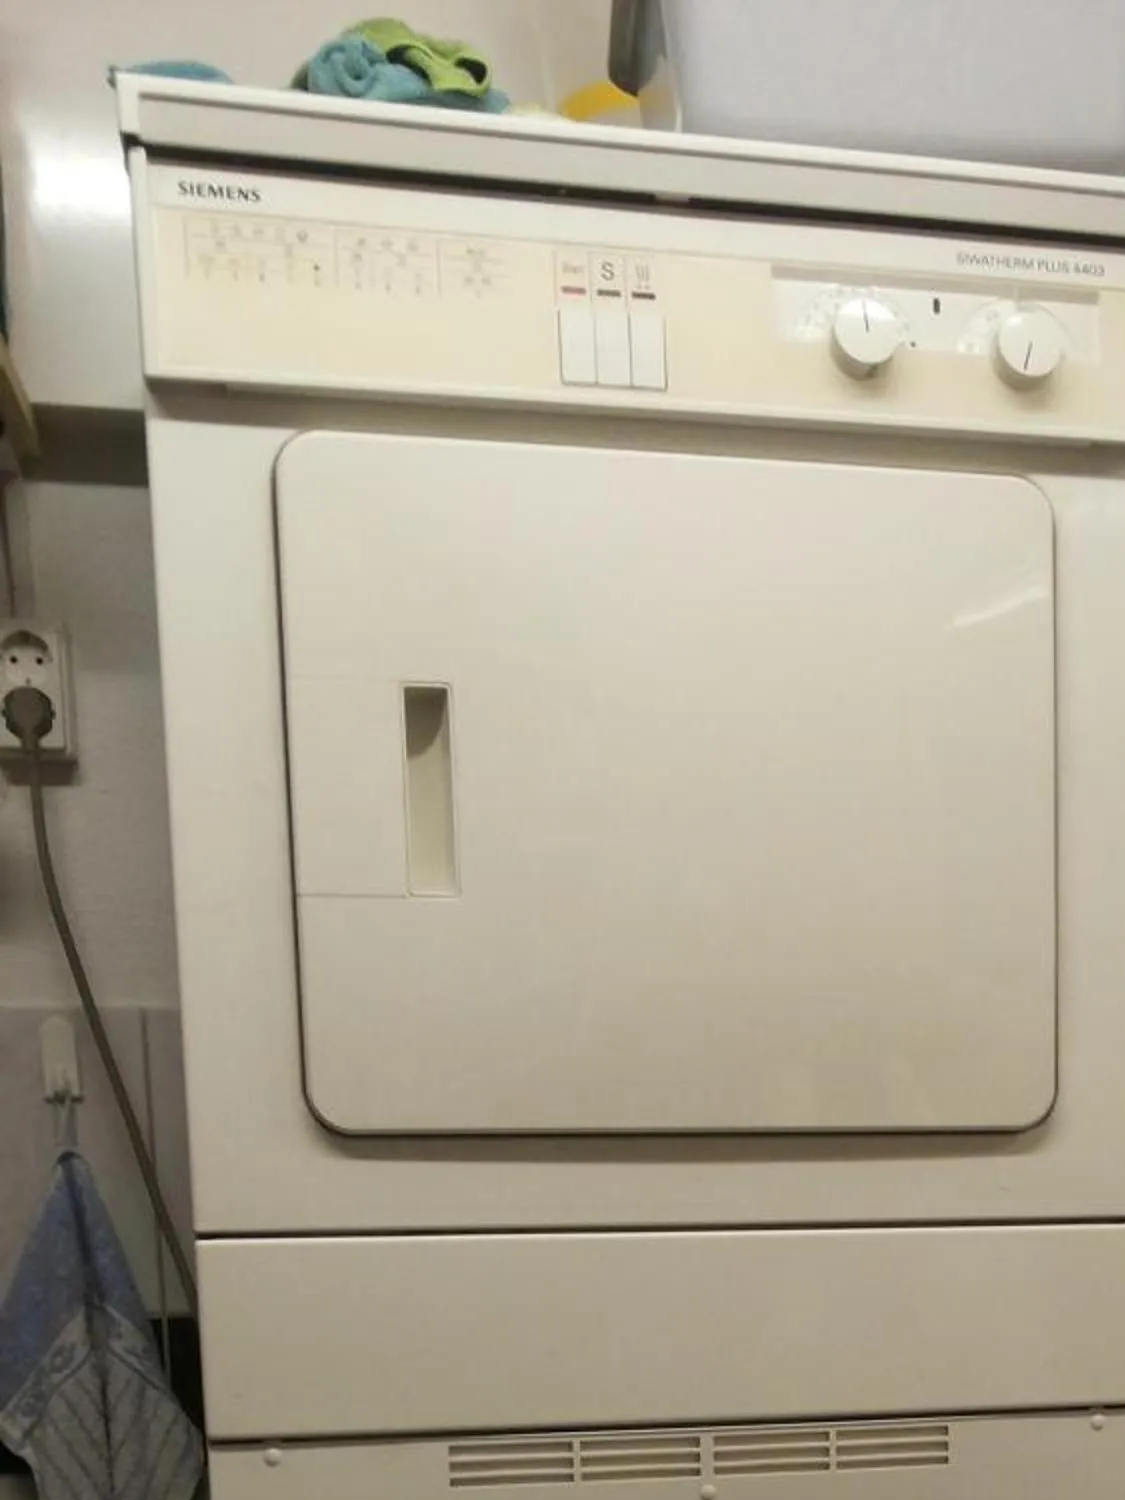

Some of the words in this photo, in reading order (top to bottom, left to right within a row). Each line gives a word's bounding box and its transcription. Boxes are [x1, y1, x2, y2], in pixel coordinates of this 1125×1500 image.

[177, 180, 261, 202] SIEMENS
[600, 260, 616, 281] S
[1037, 258, 1069, 274] PLUS
